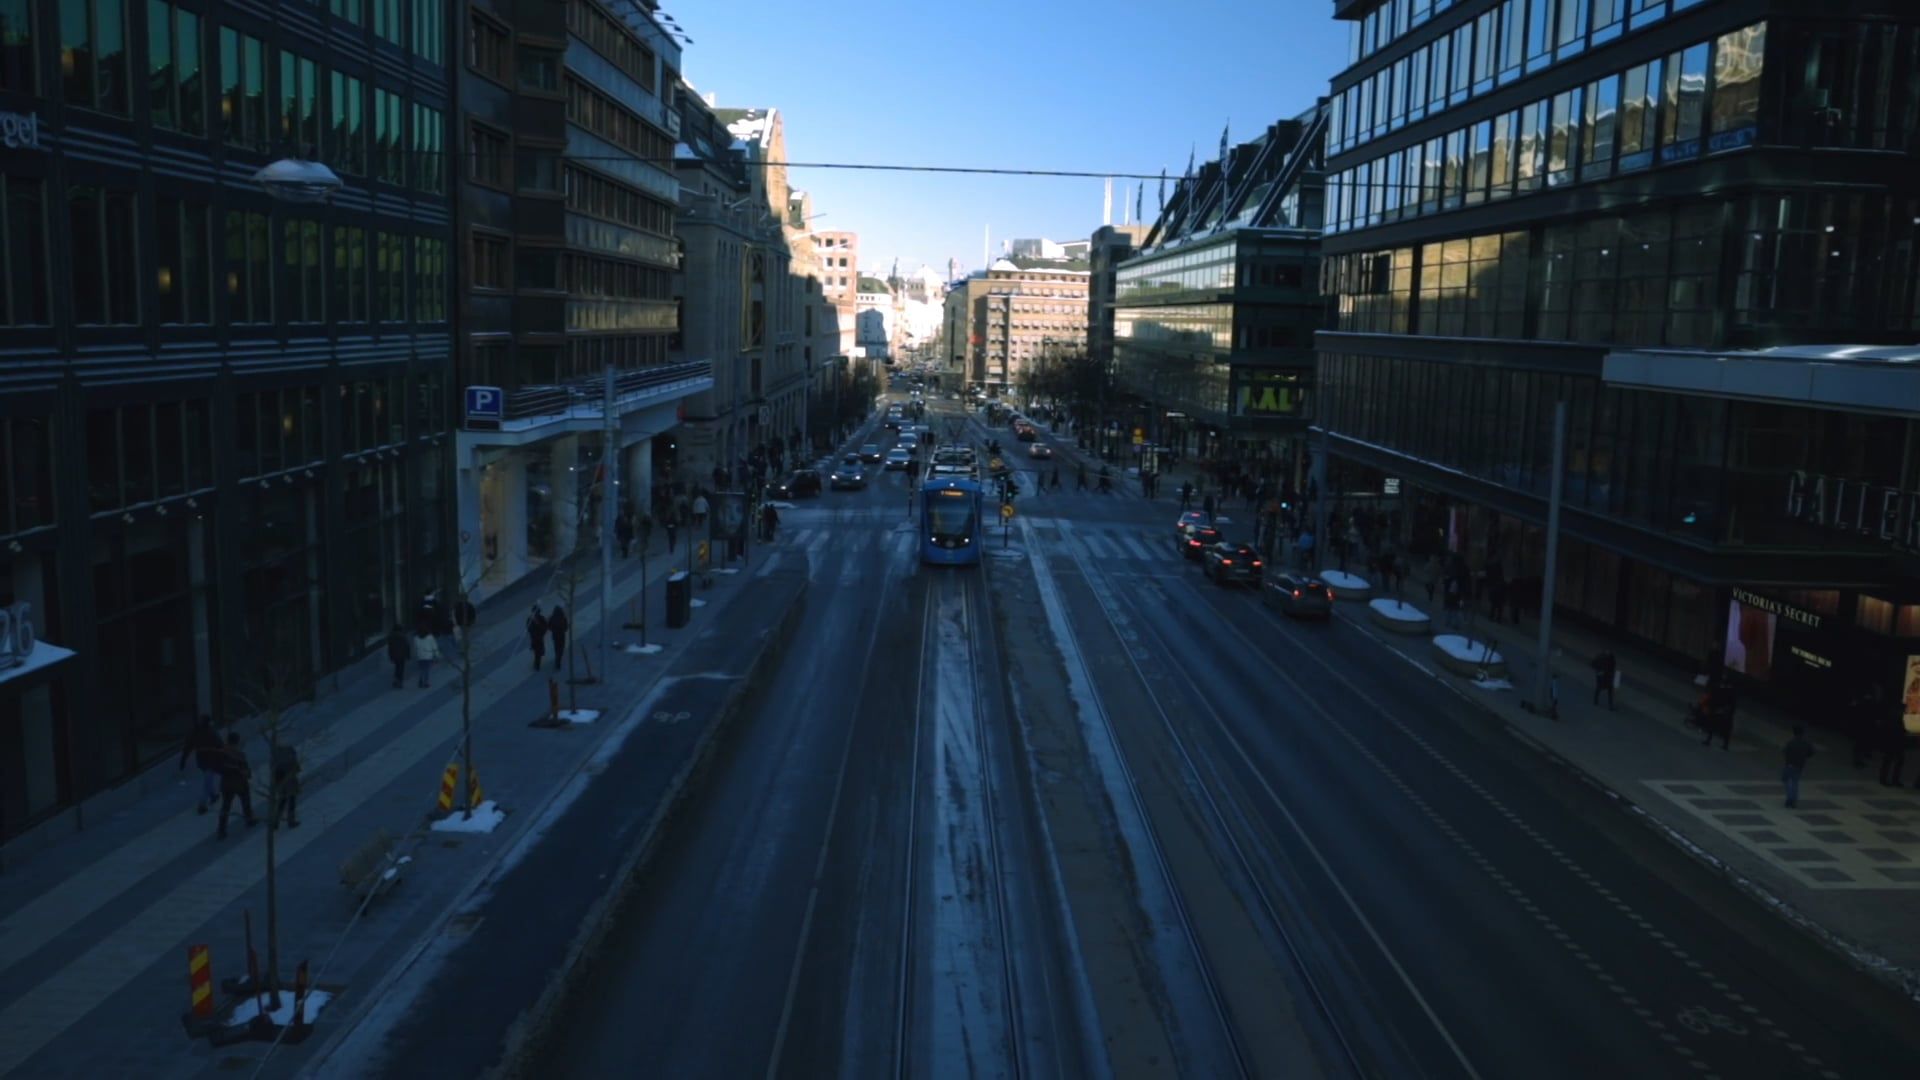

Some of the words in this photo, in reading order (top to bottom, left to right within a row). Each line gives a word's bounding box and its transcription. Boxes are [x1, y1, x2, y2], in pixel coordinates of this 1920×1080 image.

[476, 391, 492, 410] P
[1731, 586, 1782, 615] VICTORIA'S
[1783, 604, 1821, 629] SECRET
